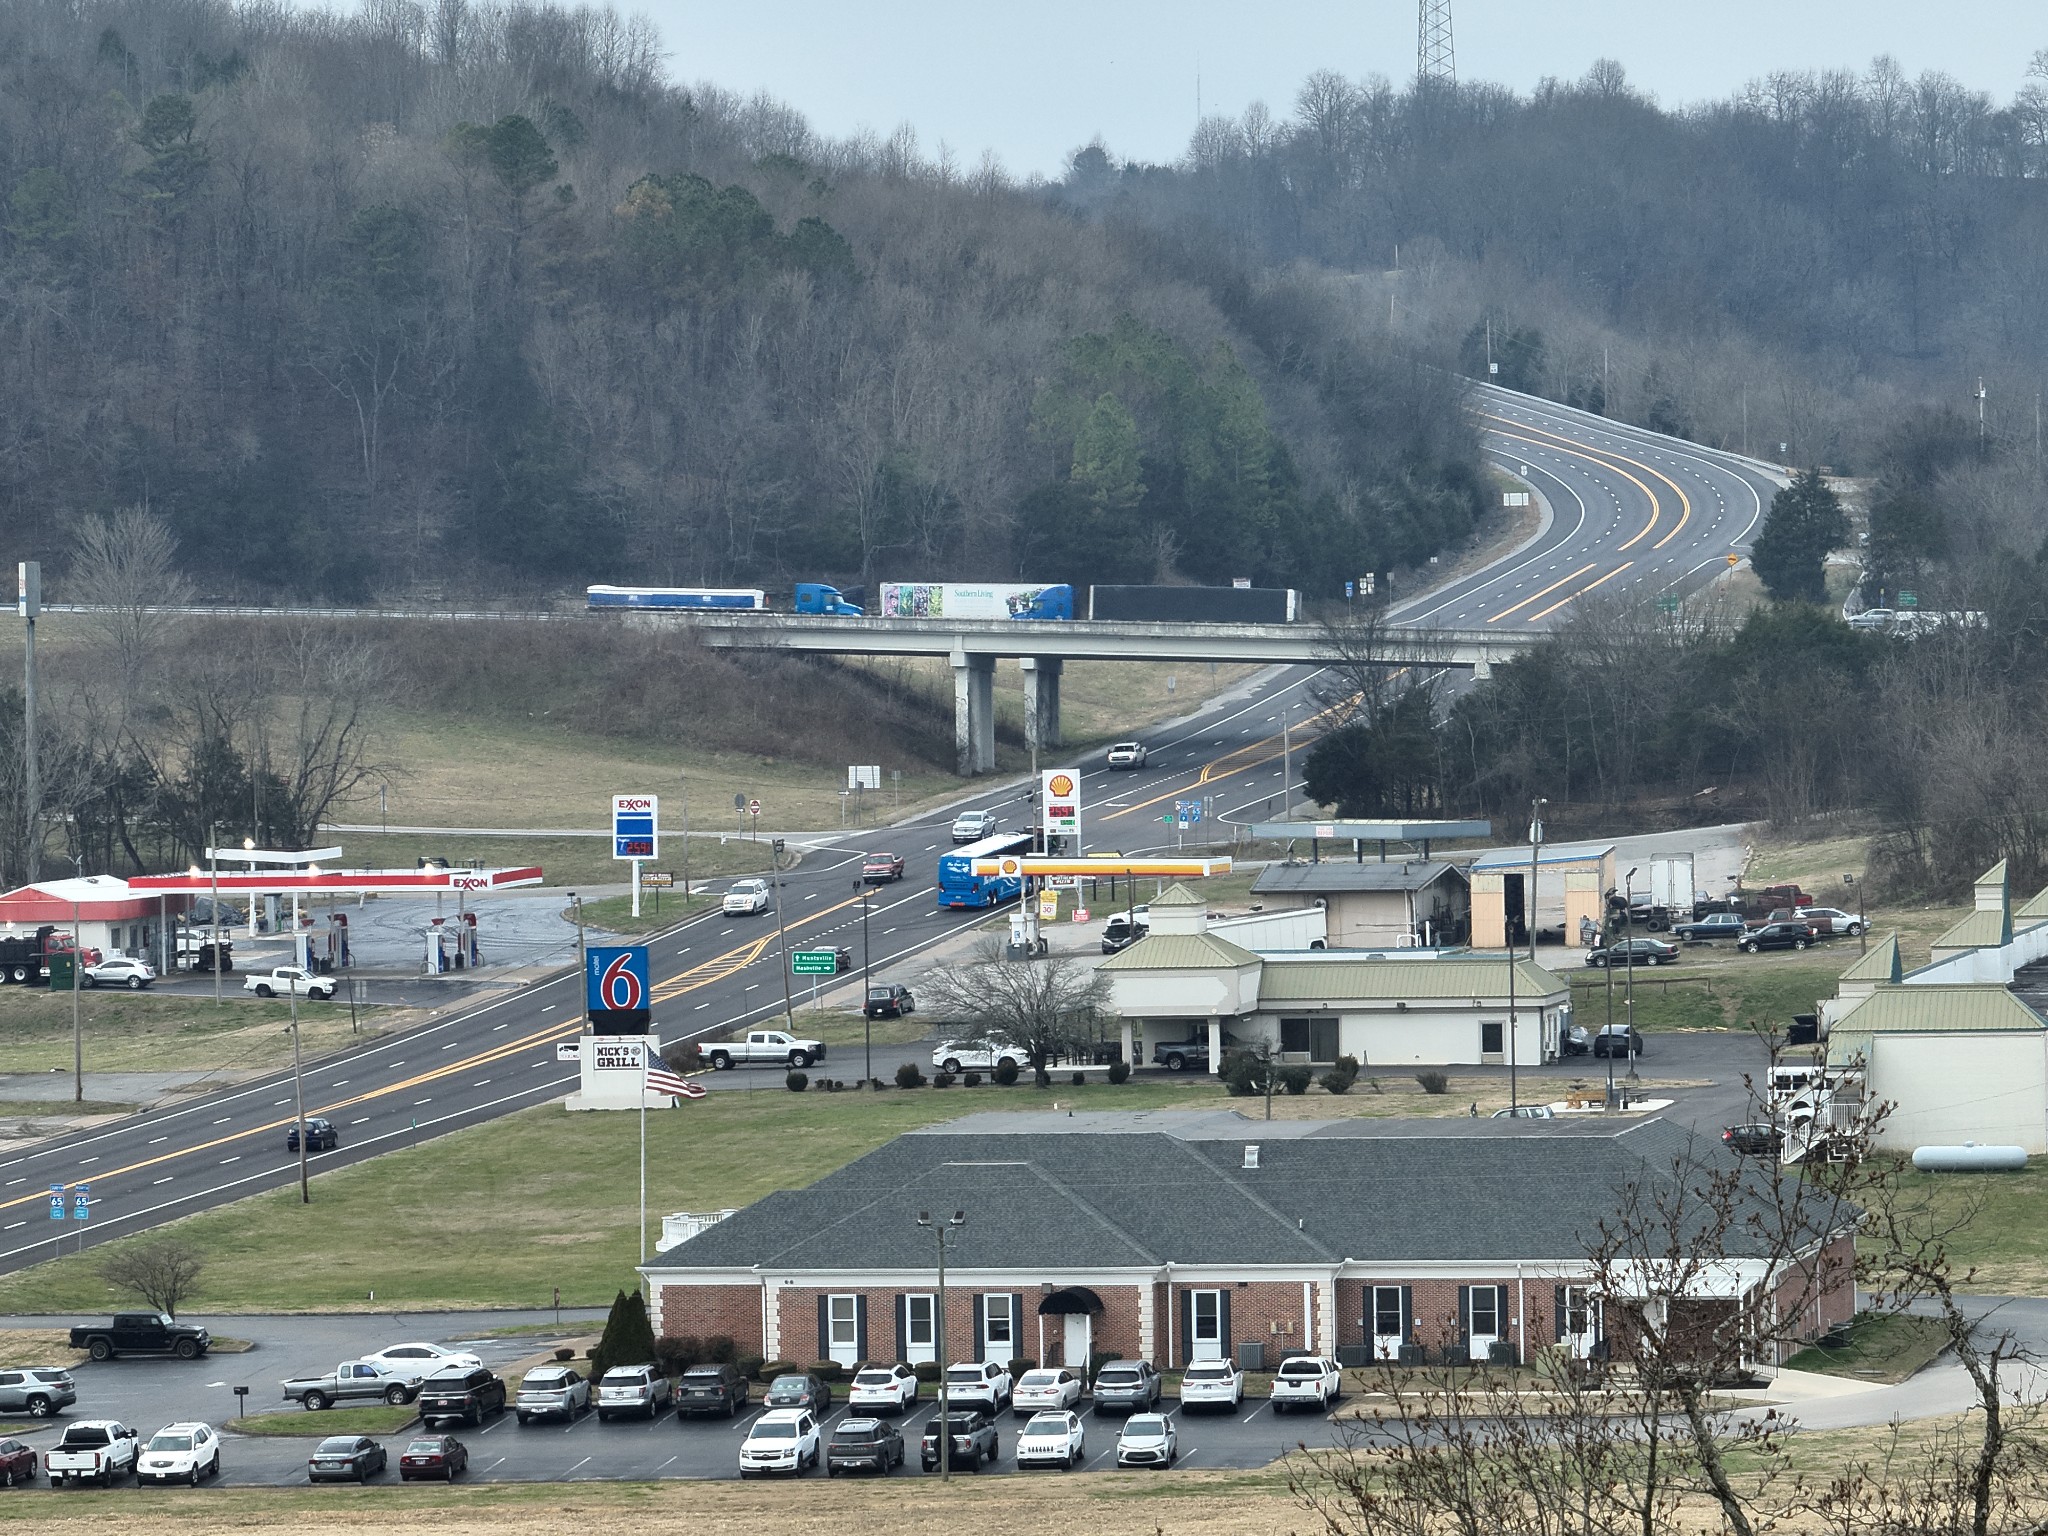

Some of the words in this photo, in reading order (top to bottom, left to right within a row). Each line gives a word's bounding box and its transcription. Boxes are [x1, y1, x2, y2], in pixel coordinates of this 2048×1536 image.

[954, 589, 977, 598] Southern
[978, 589, 993, 599] Living
[618, 799, 651, 811] EXXON
[453, 877, 488, 891] EXXON
[592, 955, 600, 976] motel
[600, 952, 642, 1010] 6
[596, 1046, 629, 1057] NICK'S
[597, 1057, 640, 1068] GRILL
[51, 1197, 63, 1206] 65
[76, 1197, 87, 1206] 65
